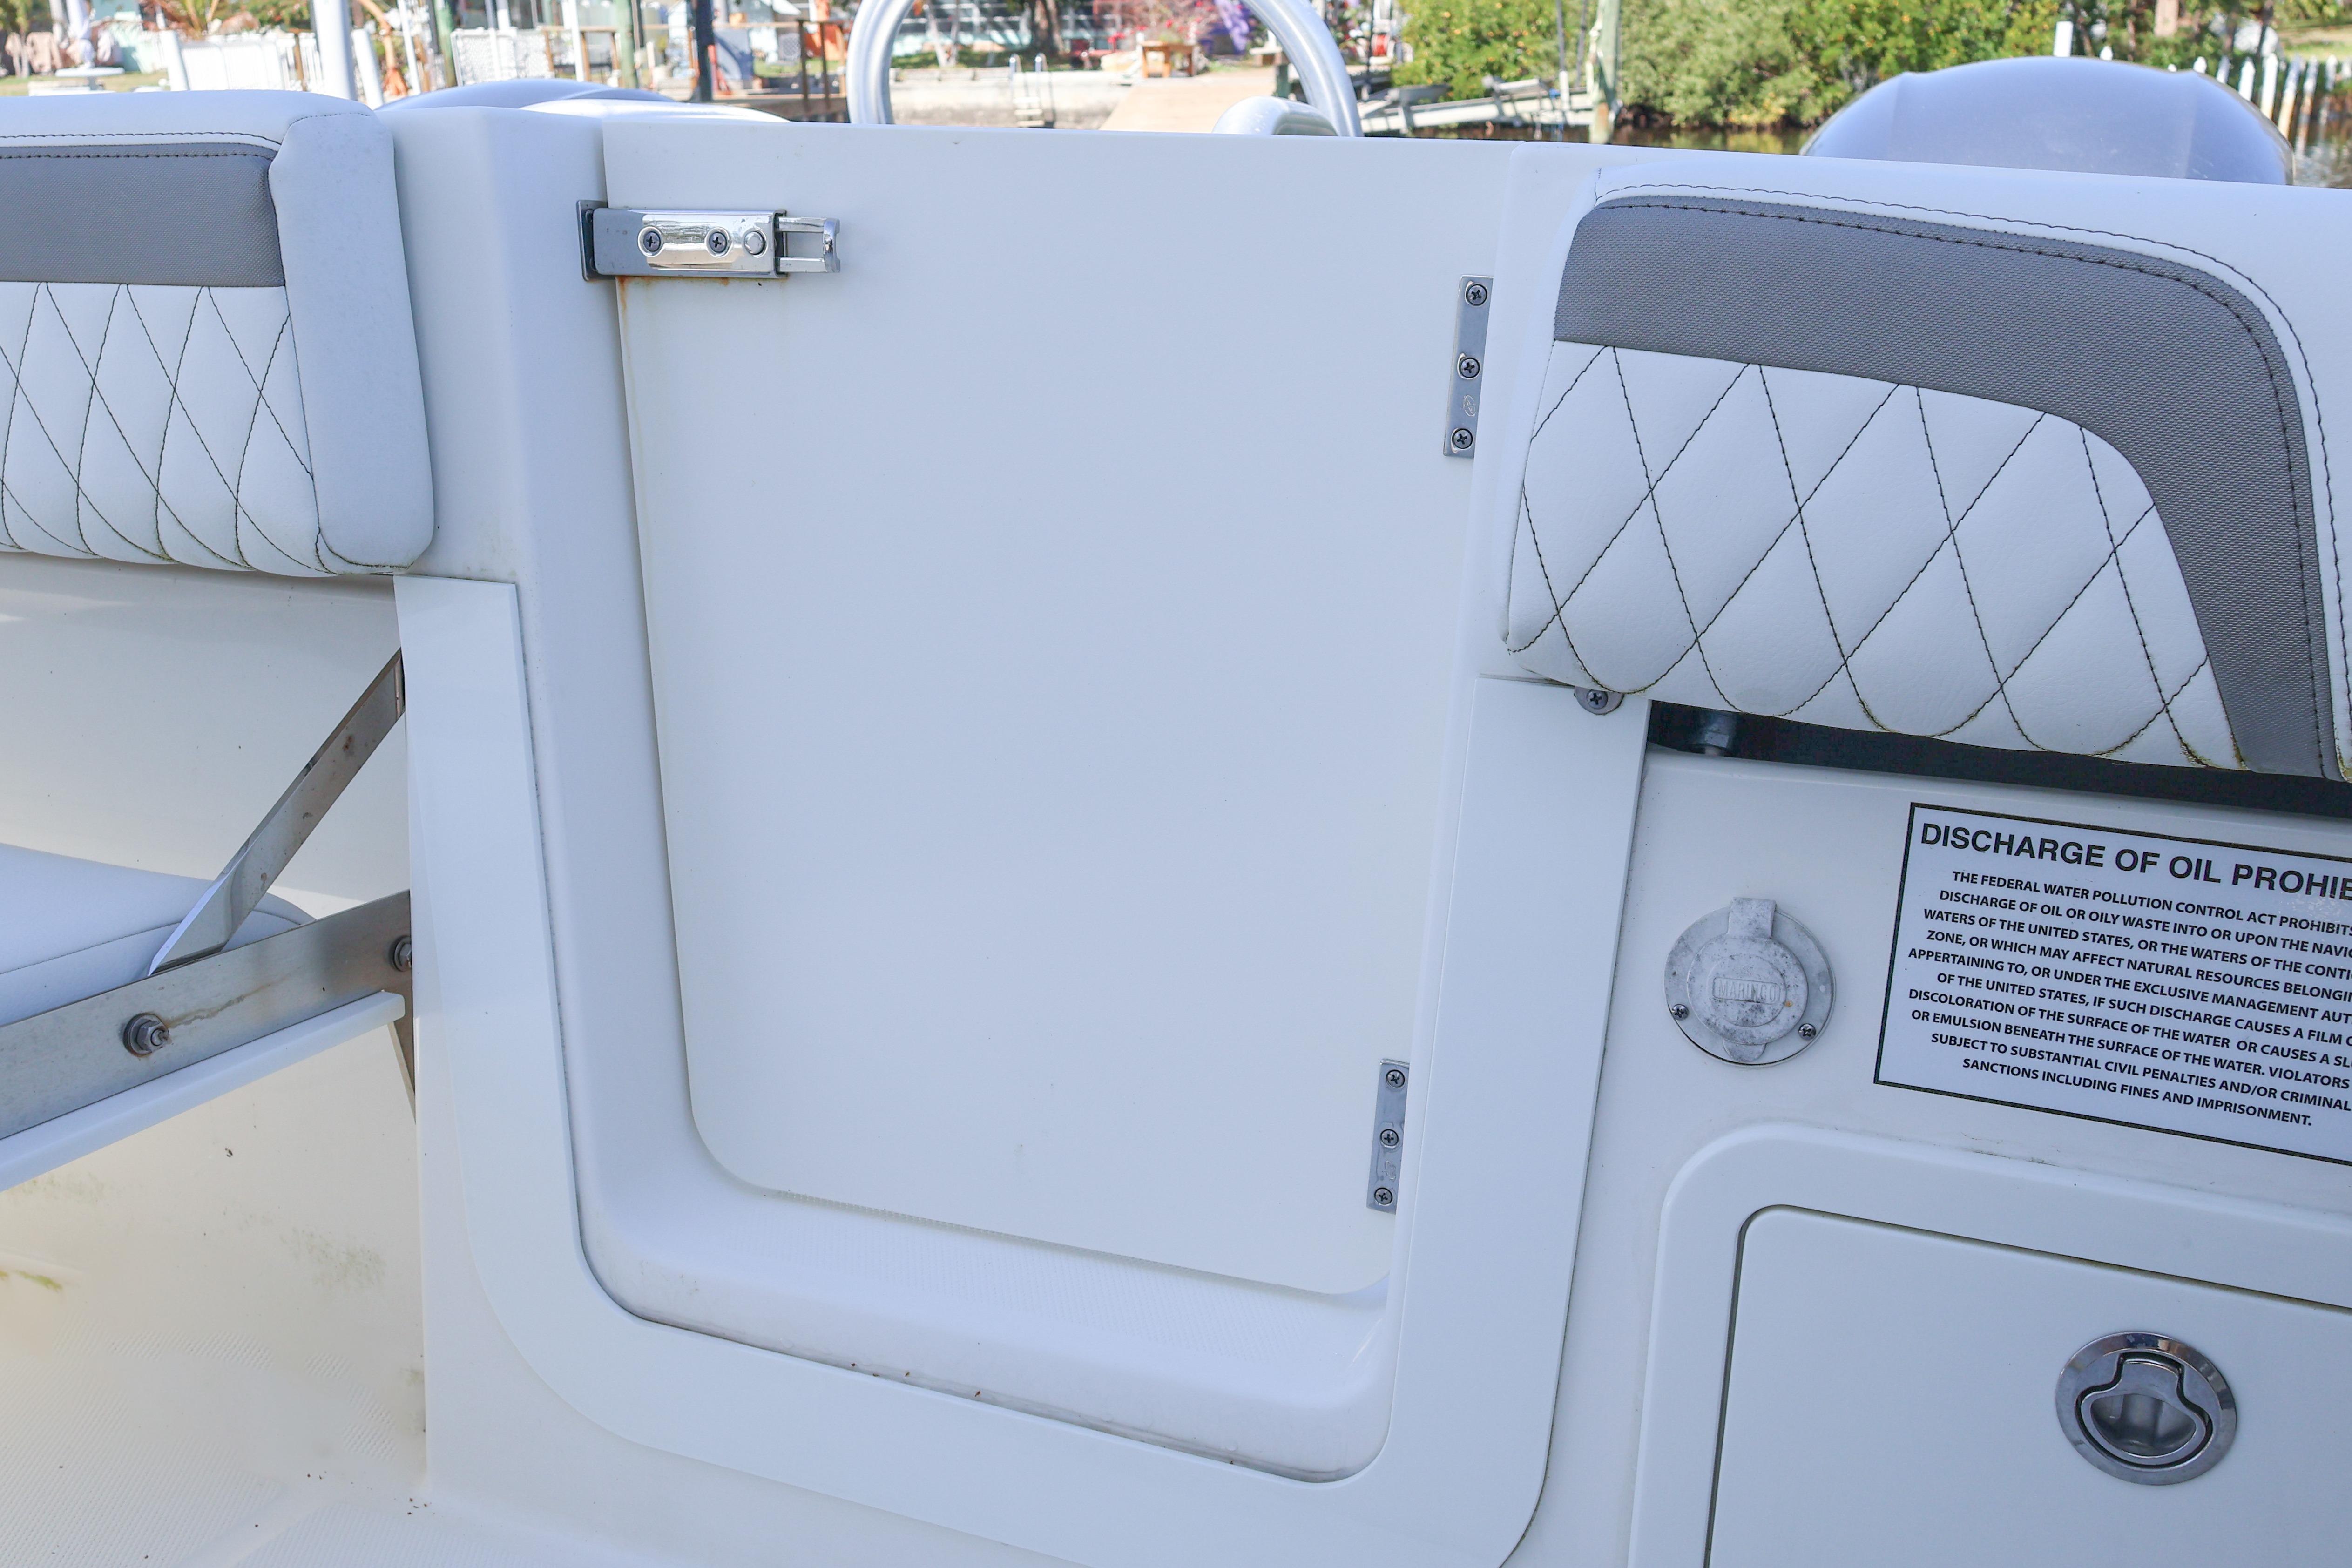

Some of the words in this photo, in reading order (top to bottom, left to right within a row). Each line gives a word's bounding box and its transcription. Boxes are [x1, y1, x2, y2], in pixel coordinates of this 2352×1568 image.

[1921, 823, 2106, 868] DISCHARGE
[2115, 848, 2161, 873] OF
[2169, 855, 2222, 884] OIL
[1939, 890, 2016, 910] DISCHARGE
[2019, 901, 2038, 913] OF
[2040, 904, 2063, 917] OIL
[2066, 908, 2086, 920] OR
[2088, 911, 2121, 925] OILY
[2122, 915, 2170, 932] WASTE
[2172, 922, 2208, 937] INTO
[2210, 928, 2232, 941] OR
[2235, 931, 2278, 947] UPON
[2280, 938, 2310, 952] THE
[1952, 871, 1979, 884] THE
[1980, 875, 2041, 893] FEDERAL
[2043, 883, 2090, 899] WATER
[2092, 890, 2173, 911] POLLUTION
[2175, 902, 2244, 921] CONTROL
[2246, 912, 2277, 925] ACT
[1924, 908, 1976, 925] WATERS
[1978, 917, 1997, 928] OF
[1999, 919, 2025, 933] THE
[2028, 923, 2079, 940] UNITED
[2082, 931, 2134, 950] STATES,
[2137, 939, 2158, 952] OR
[2160, 942, 2189, 956] THE
[2191, 946, 2248, 965] WATERS
[2251, 956, 2271, 968] OF
[2273, 959, 2303, 973] THE
[2305, 964, 2352, 980] CONTI
[1926, 930, 1966, 946] ZONE,
[1969, 936, 1988, 948] OR
[1991, 939, 2037, 955] WHICH
[2039, 946, 2070, 960] MAY
[2071, 951, 2125, 968] AFFECT
[2126, 959, 2192, 979] NATURAL
[2195, 969, 2281, 991] RESOURCES
[1719, 979, 1776, 1002] MARINCO
[1908, 948, 2004, 971] APPERTAINING
[2007, 962, 2028, 976] TO,
[2031, 966, 2051, 979] OR
[2054, 969, 2102, 986] UNDER
[2104, 976, 2131, 991] THE
[2133, 981, 2210, 1002] EXCLUSIVE
[2211, 993, 2319, 1019] MANAGEMENT
[2320, 1010, 2352, 1024] AUT
[1937, 973, 1955, 984] OF
[1957, 975, 1983, 989] THE
[1986, 980, 2036, 996] UNITED
[2038, 988, 2090, 1007] STATES,
[2093, 996, 2106, 1007] IF
[2108, 999, 2147, 1014] SUCH
[2149, 1005, 2232, 1027] DISCHARGE
[2234, 1018, 2291, 1036] CAUSES
[2292, 1027, 2304, 1039] A
[2307, 1029, 2343, 1045] FILM
[1909, 988, 2015, 1014] DISCOLORATION
[2017, 1006, 2036, 1017] OF
[2038, 1008, 2065, 1022] THE
[2067, 1013, 2129, 1032] SURFACE
[2130, 1023, 2150, 1035] OF
[2152, 1026, 2180, 1041] THE
[2183, 1031, 2230, 1049] WATER
[2236, 1040, 2258, 1053] OR
[2260, 1044, 2317, 1062] CAUSES
[2319, 1054, 2330, 1065] A
[2333, 1055, 2352, 1068] SL
[1911, 1009, 1930, 1021] OR
[1933, 1013, 2002, 1033] EMULSION
[2004, 1024, 2066, 1043] BENEATH
[2068, 1034, 2095, 1048] THE
[2096, 1039, 2159, 1058] SURFACE
[2161, 1049, 2181, 1061] OF
[2183, 1052, 2211, 1067] THE
[2213, 1057, 2265, 1076] WATER.
[2269, 1066, 2351, 1089] VIOLATORS
[1931, 1033, 1988, 1051] SUBJECT
[1990, 1042, 2007, 1054] TO
[2010, 1046, 2102, 1070] SUBSTANTIAL
[2104, 1061, 2139, 1076] CIVIL
[2142, 1067, 2217, 1088] PENALTIES
[2218, 1080, 2278, 1099] AND/OR
[2280, 1090, 2352, 1112] CRIMINAL
[1962, 1058, 2039, 1080] SANCTIONS
[2041, 1071, 2117, 1093] INCLUDING
[2120, 1084, 2160, 1100] FINES
[2162, 1091, 2194, 1105] AND
[2197, 1096, 2312, 1126] IMPRISONMENT.
